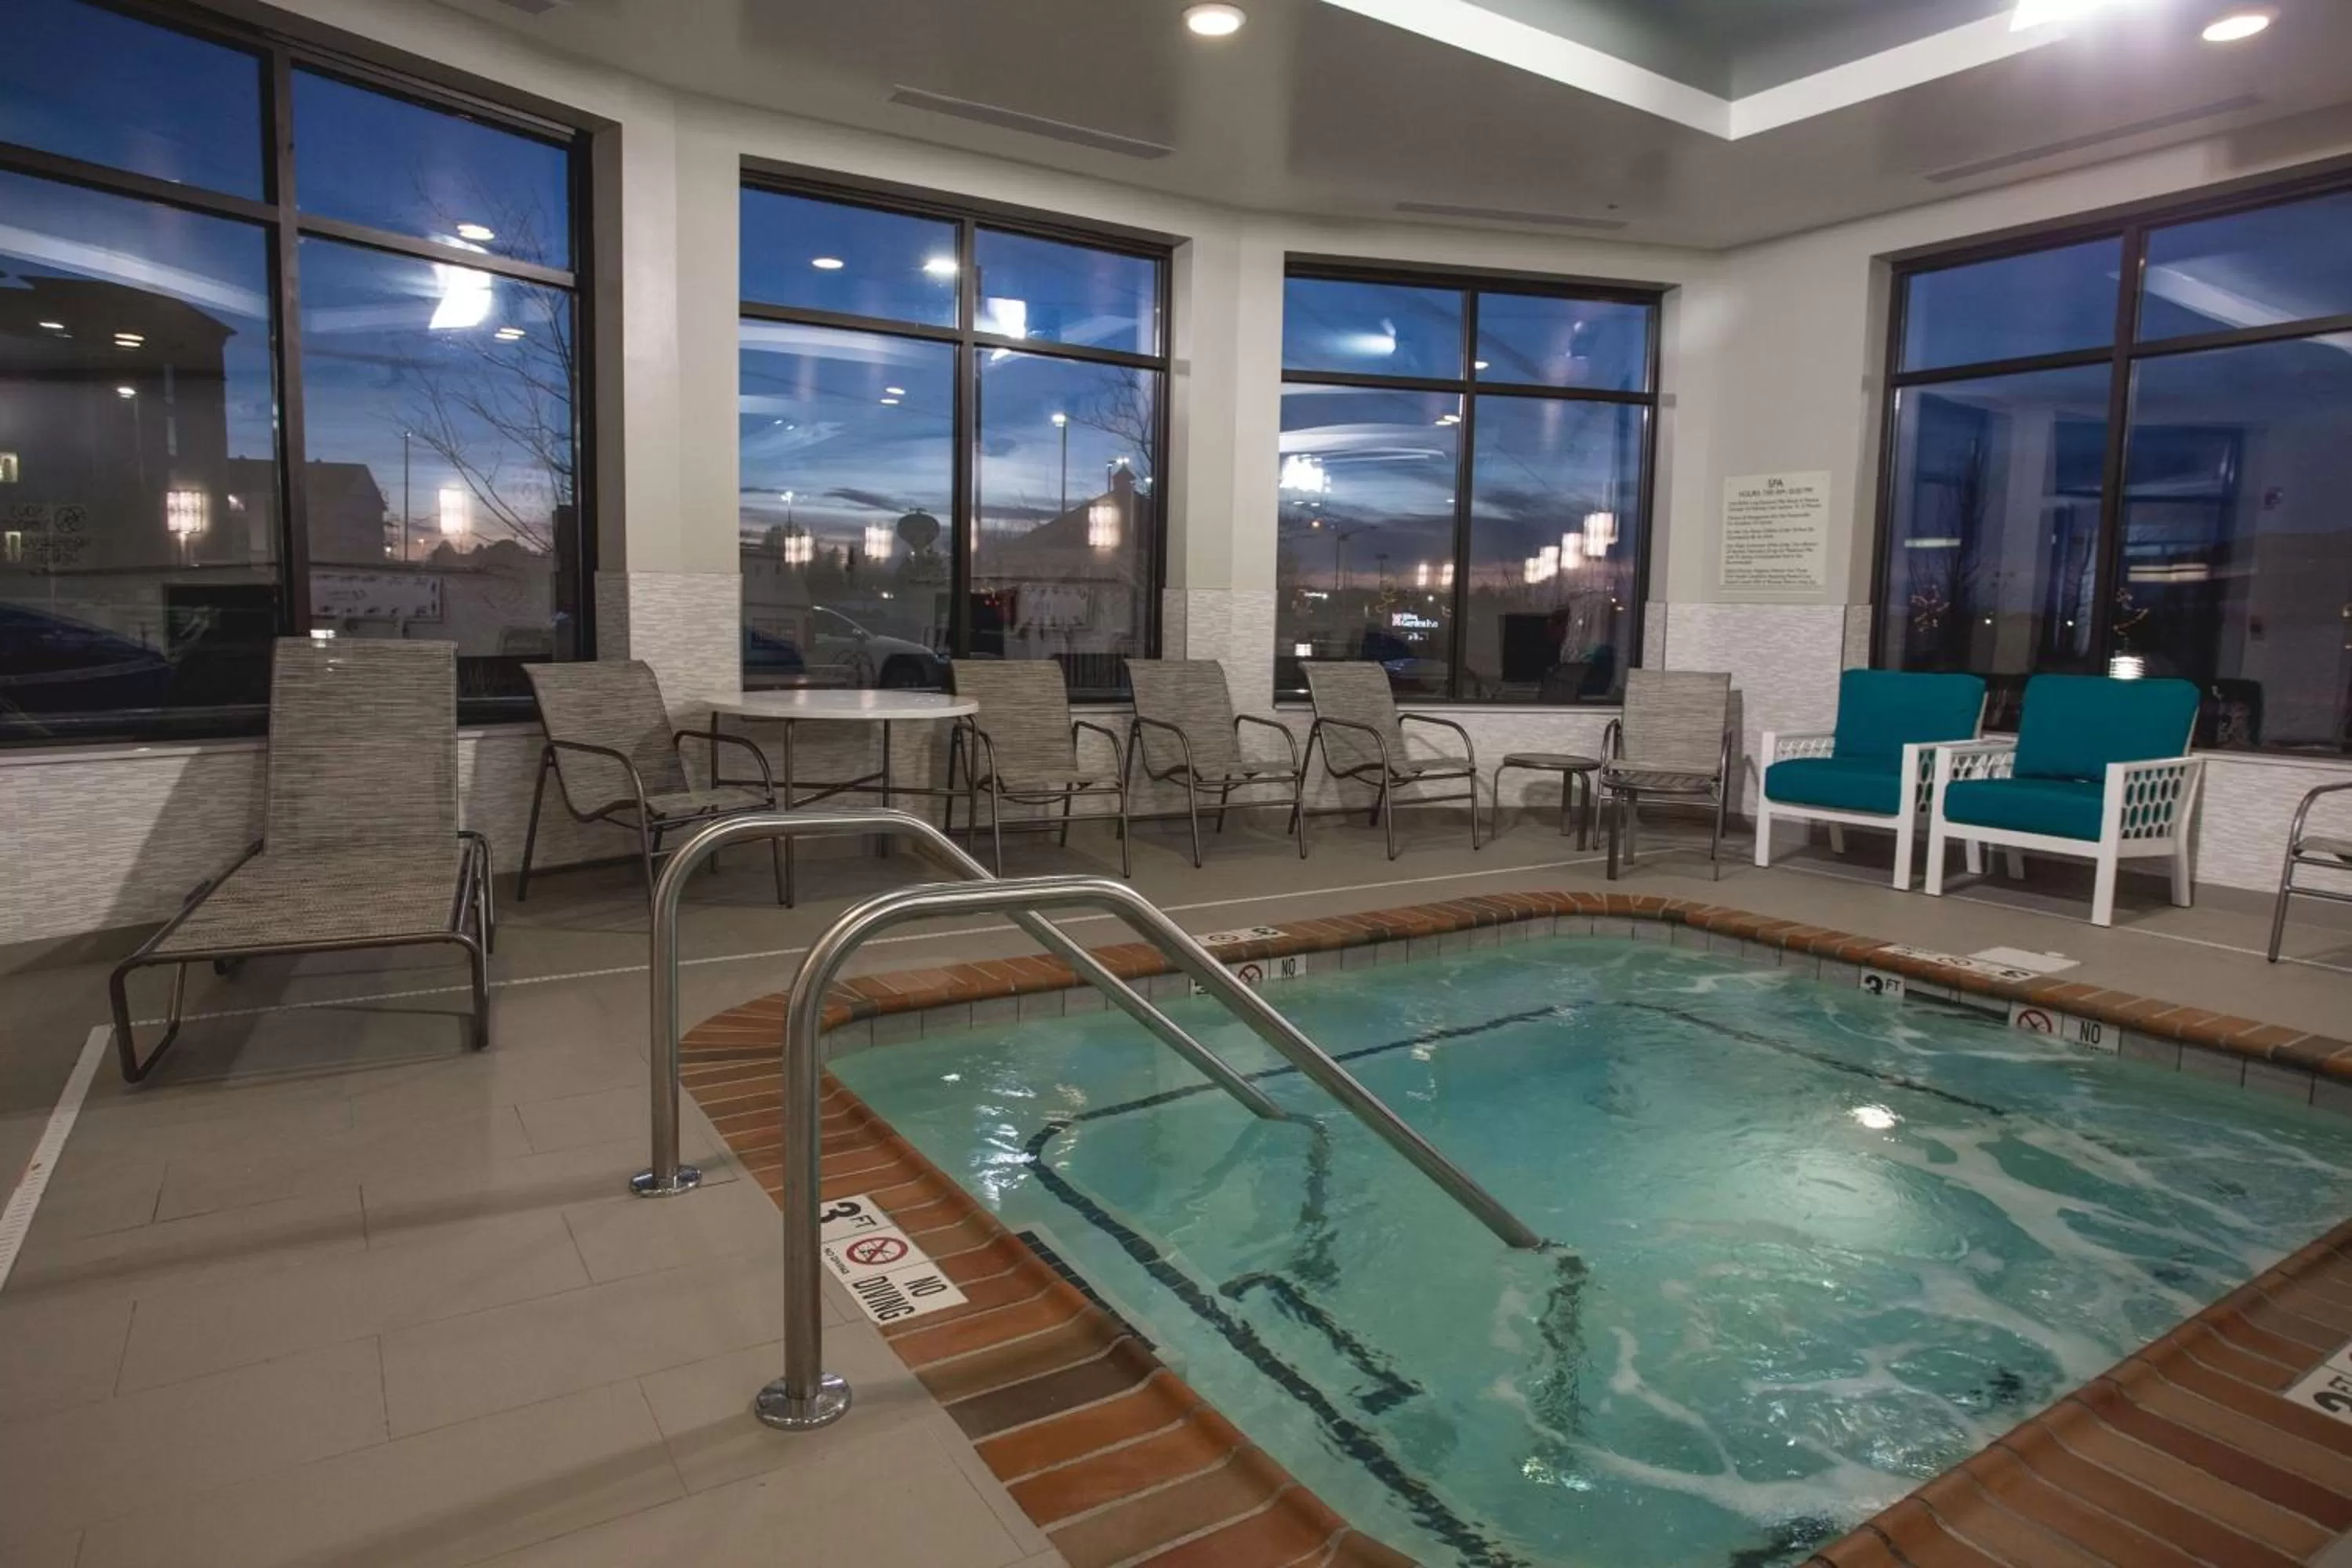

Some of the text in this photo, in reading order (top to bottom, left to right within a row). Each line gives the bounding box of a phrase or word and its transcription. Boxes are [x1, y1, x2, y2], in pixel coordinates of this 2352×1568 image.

[1768, 479, 1784, 488] SPA
[1282, 959, 1296, 978] NO
[1865, 975, 1901, 994] 3 FT
[2080, 1022, 2100, 1044] NO
[850, 1215, 877, 1229] FT
[905, 1276, 947, 1298] NO
[852, 1276, 914, 1320] DIVING
